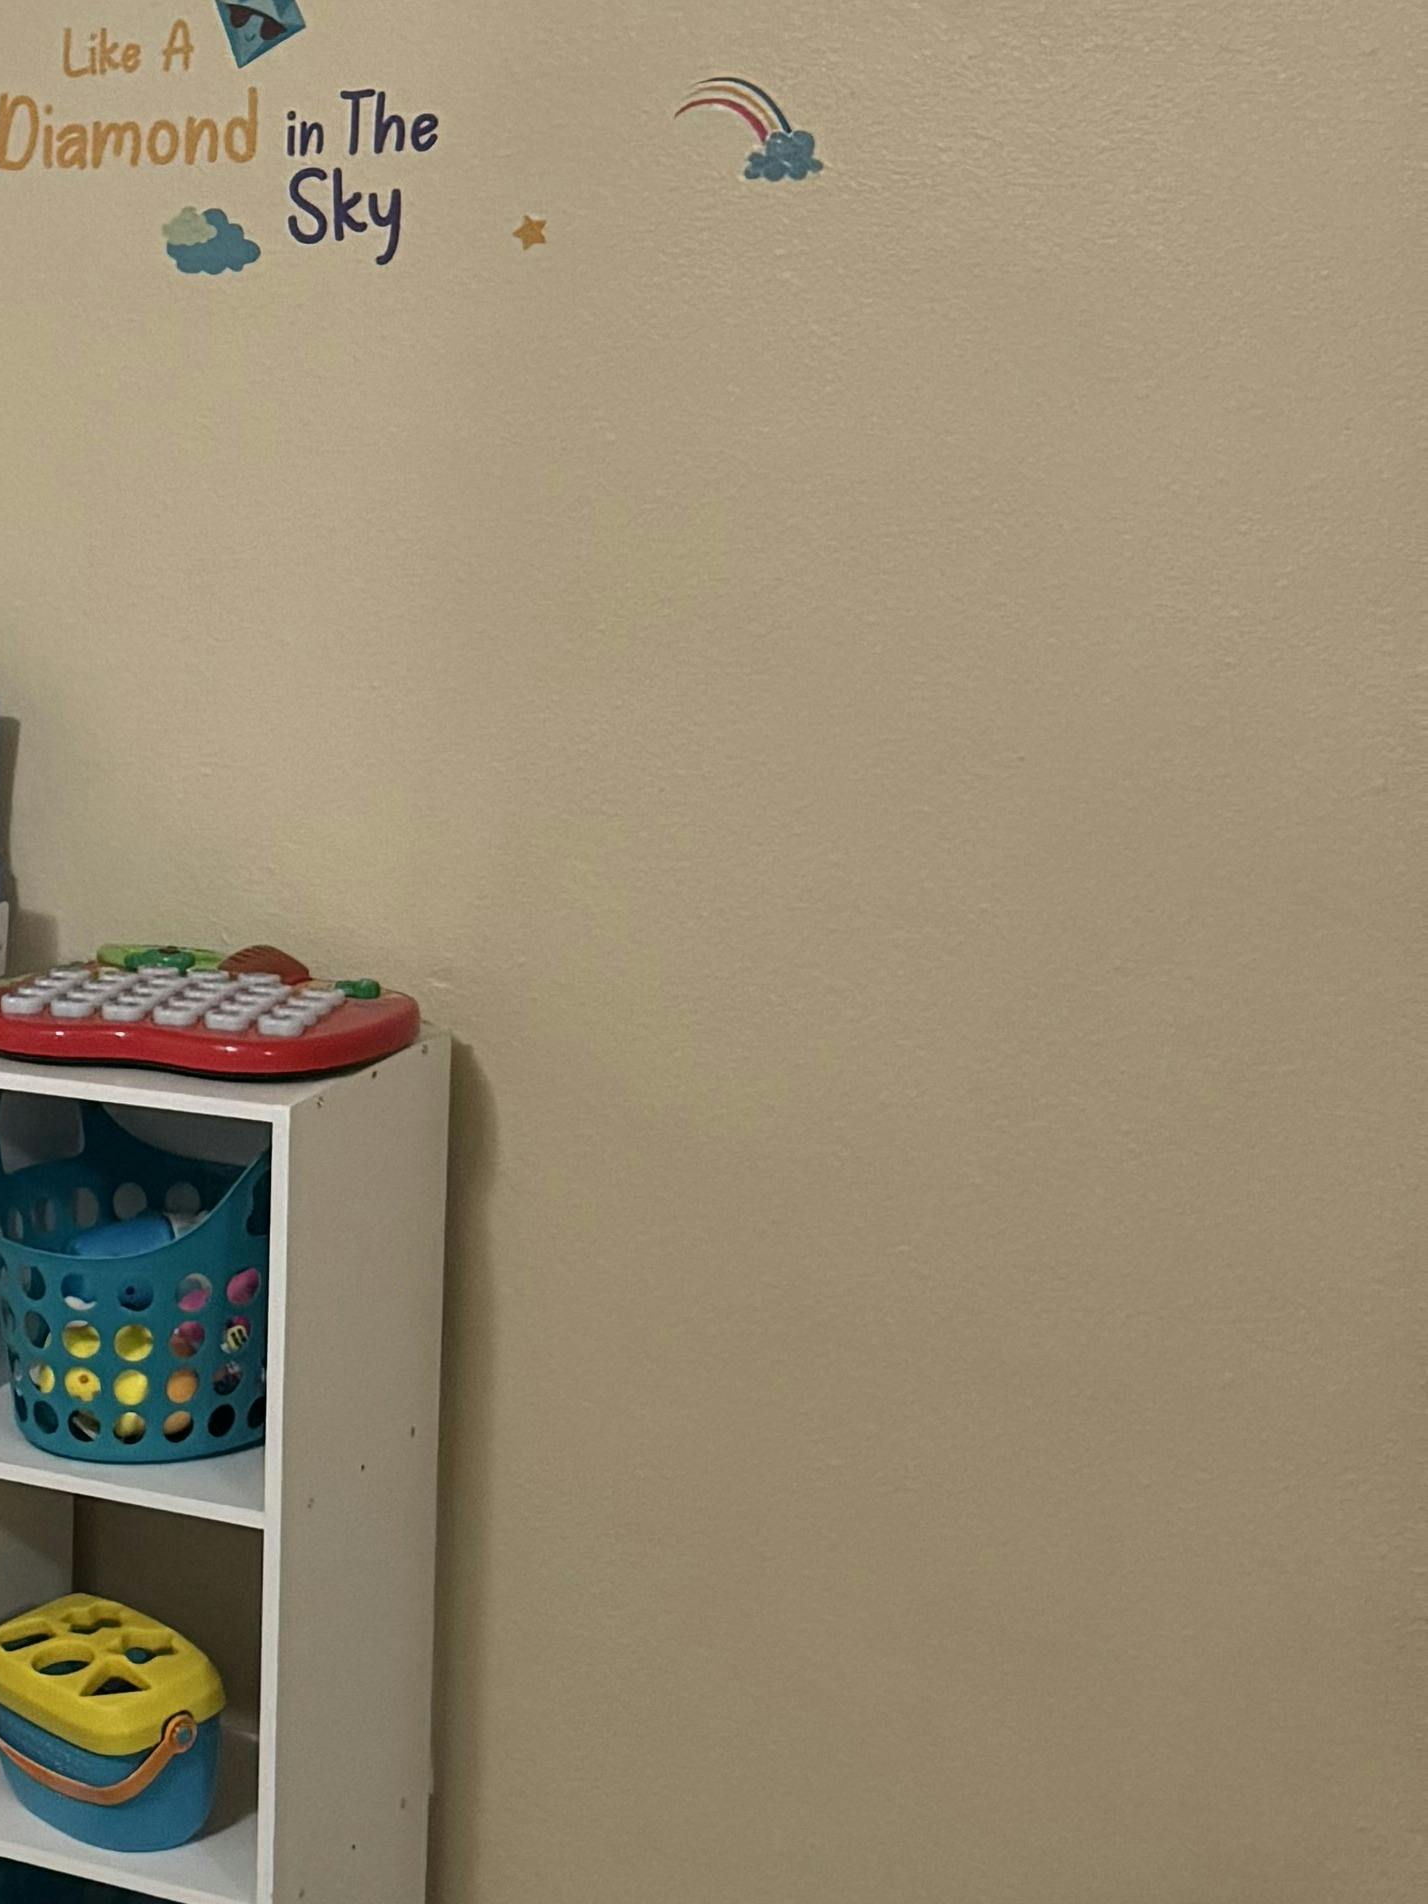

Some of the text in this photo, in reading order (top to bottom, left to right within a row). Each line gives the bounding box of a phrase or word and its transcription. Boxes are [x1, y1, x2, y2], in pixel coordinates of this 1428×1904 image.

[64, 20, 193, 77] Like A
[287, 111, 324, 156] in
[340, 89, 439, 155] The
[288, 167, 401, 265] Sky
